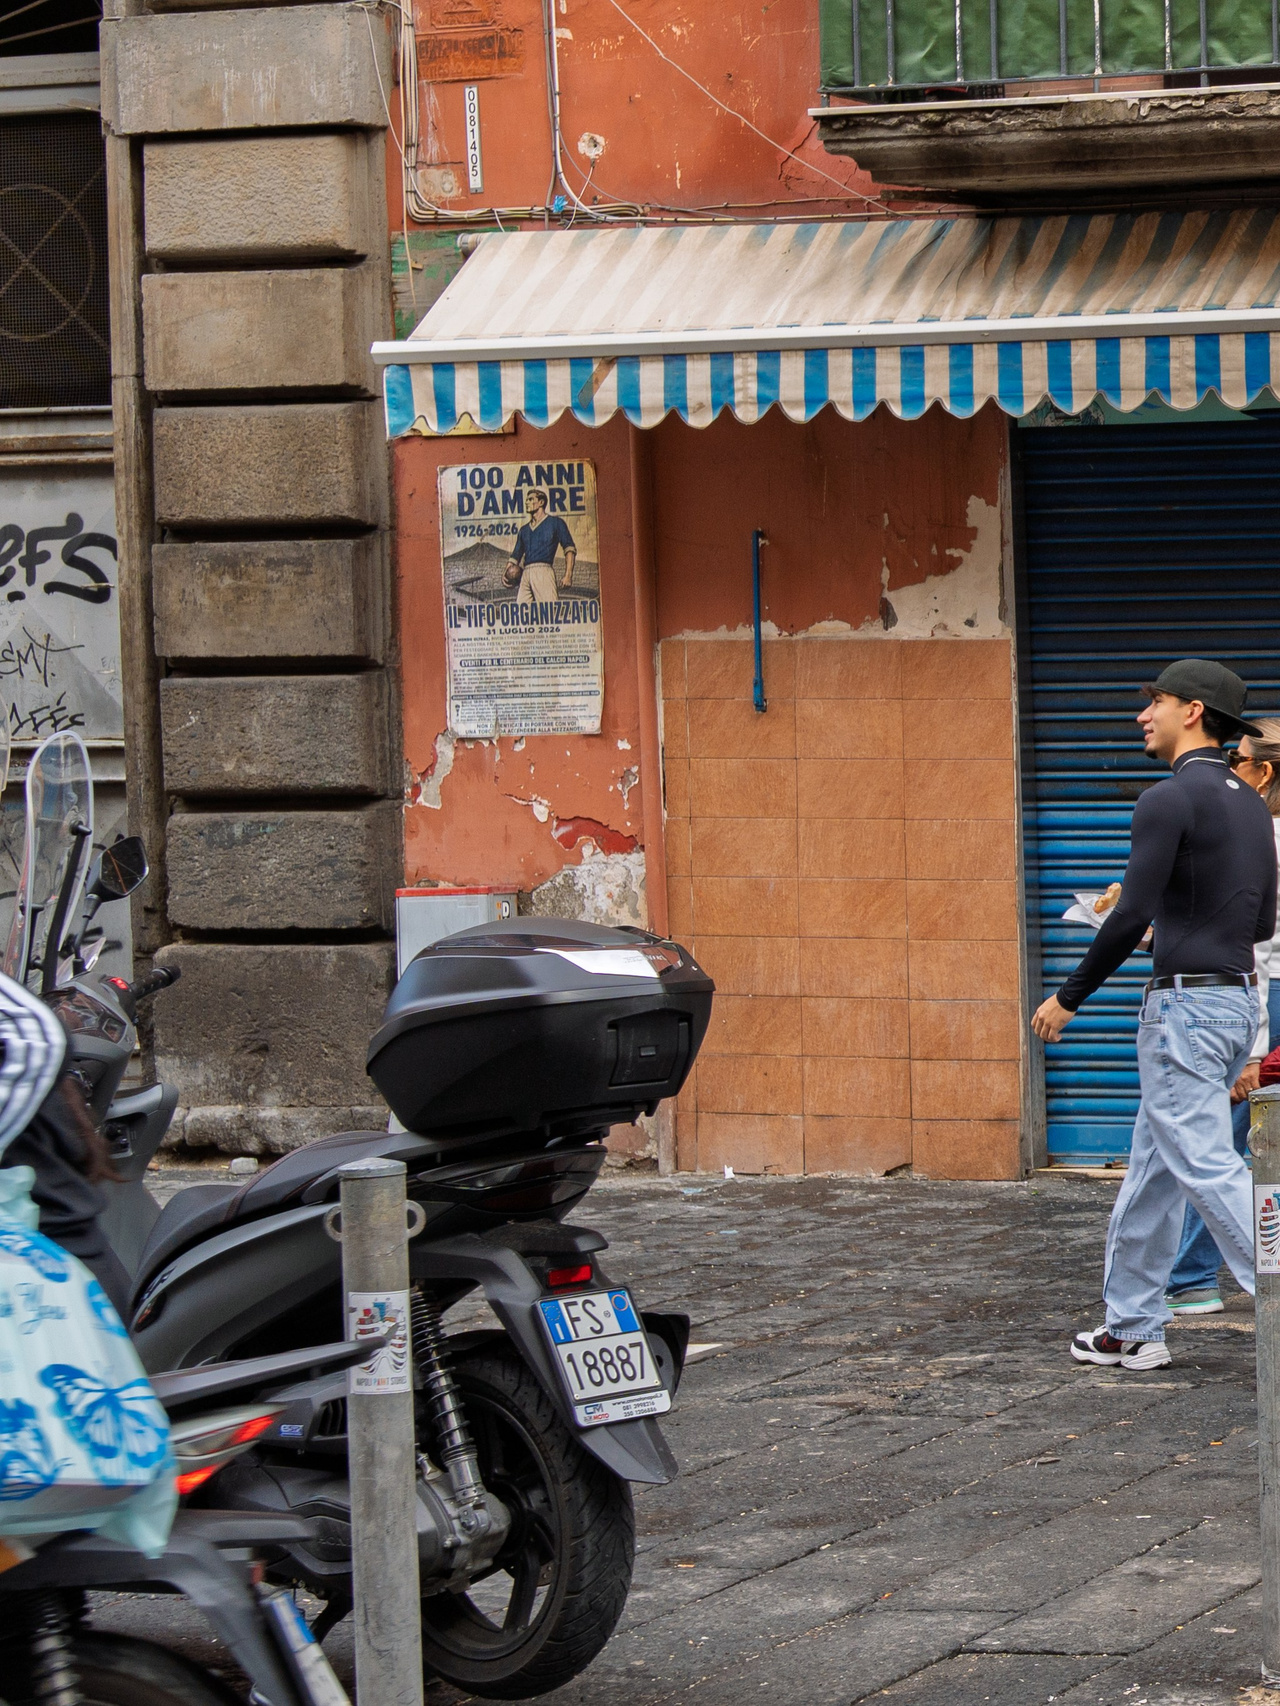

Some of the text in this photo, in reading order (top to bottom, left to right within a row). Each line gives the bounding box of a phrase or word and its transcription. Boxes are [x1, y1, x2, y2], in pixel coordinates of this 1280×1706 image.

[467, 90, 478, 177] 0081405
[457, 463, 584, 490] 100 ANNI
[457, 486, 586, 516] D'AMRE
[454, 523, 519, 538] 1926-2026
[448, 601, 599, 628] IL TIFO ORGANIZZATO
[499, 657, 534, 665] CENTENARIO
[534, 656, 545, 664] DEL
[567, 655, 589, 663] NAPOLI
[563, 1299, 604, 1338] FS
[567, 1341, 645, 1390] 18887
